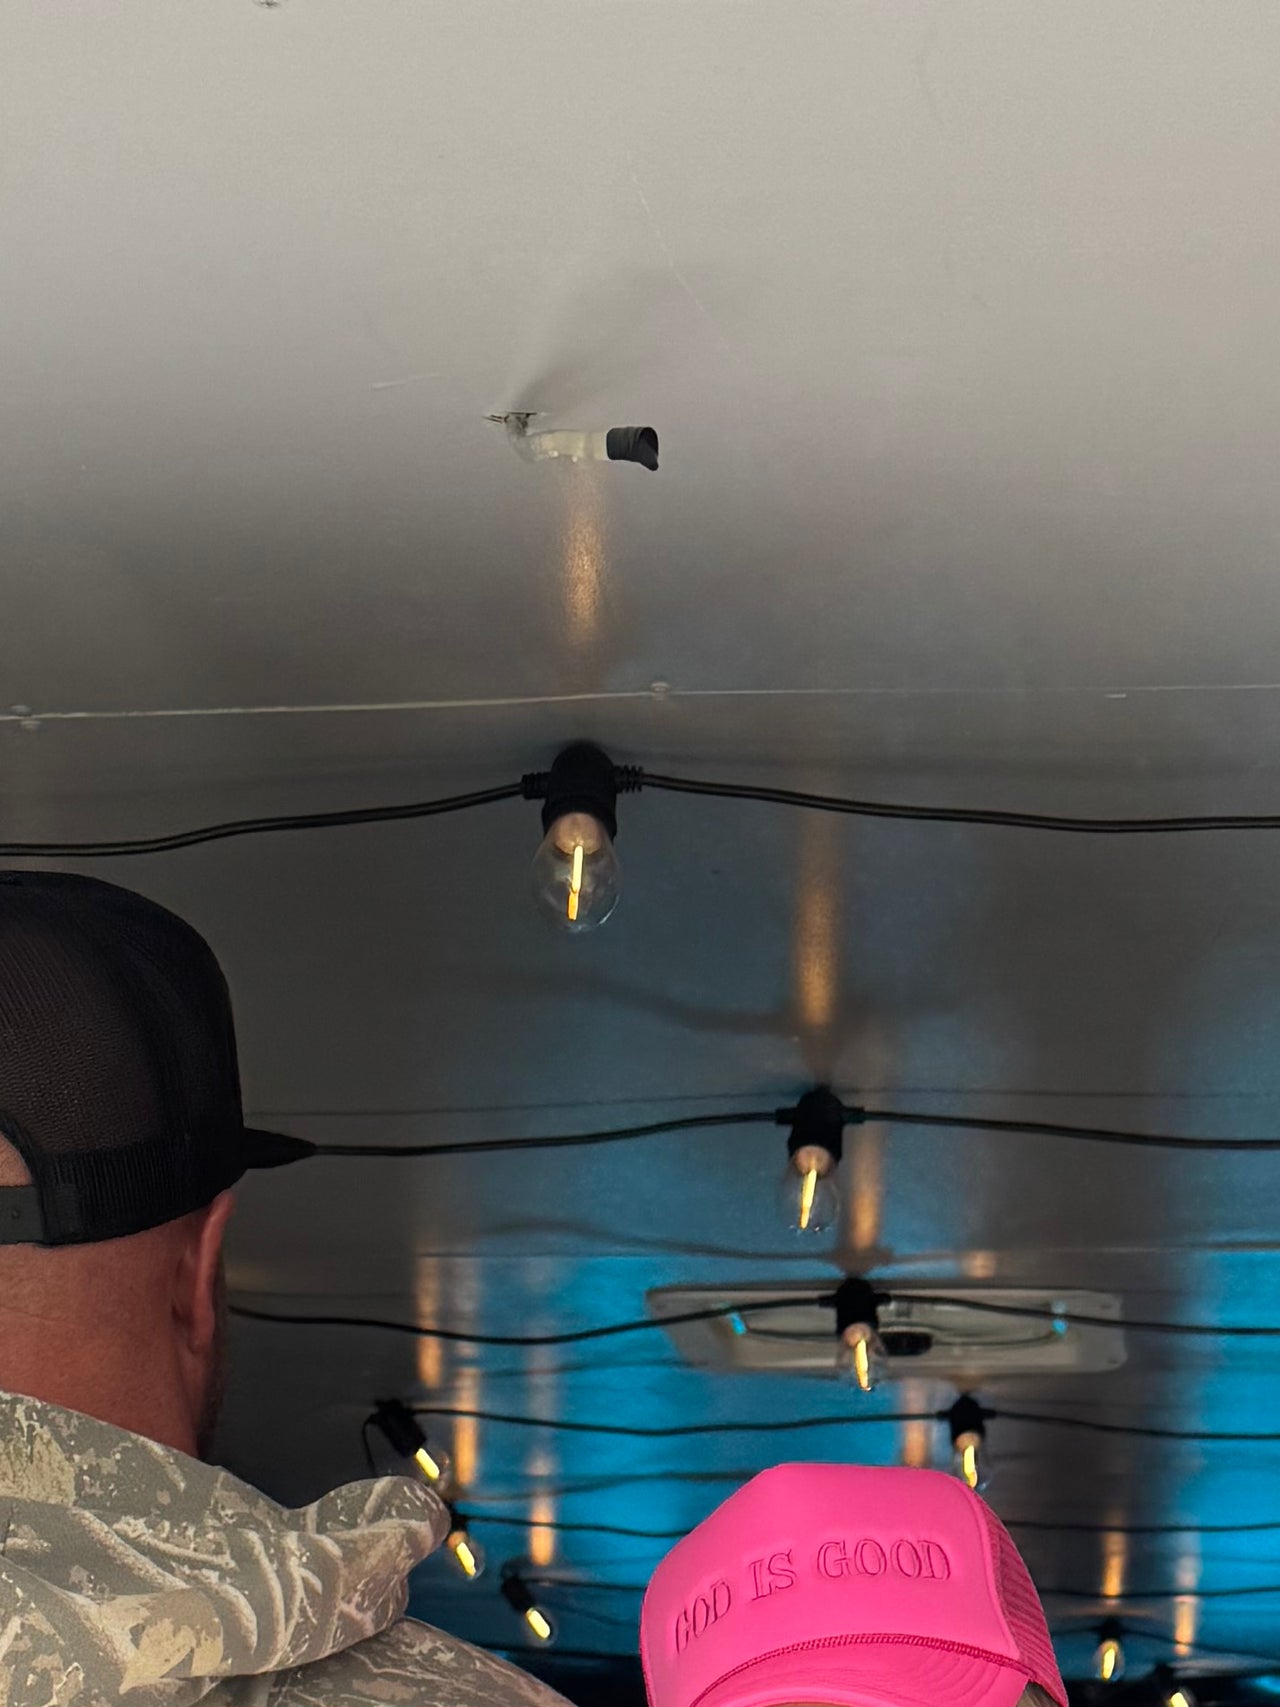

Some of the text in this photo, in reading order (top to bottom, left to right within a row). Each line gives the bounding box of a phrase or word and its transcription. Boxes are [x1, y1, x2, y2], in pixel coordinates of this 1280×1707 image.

[674, 1538, 952, 1656] GOD IS GOOD
